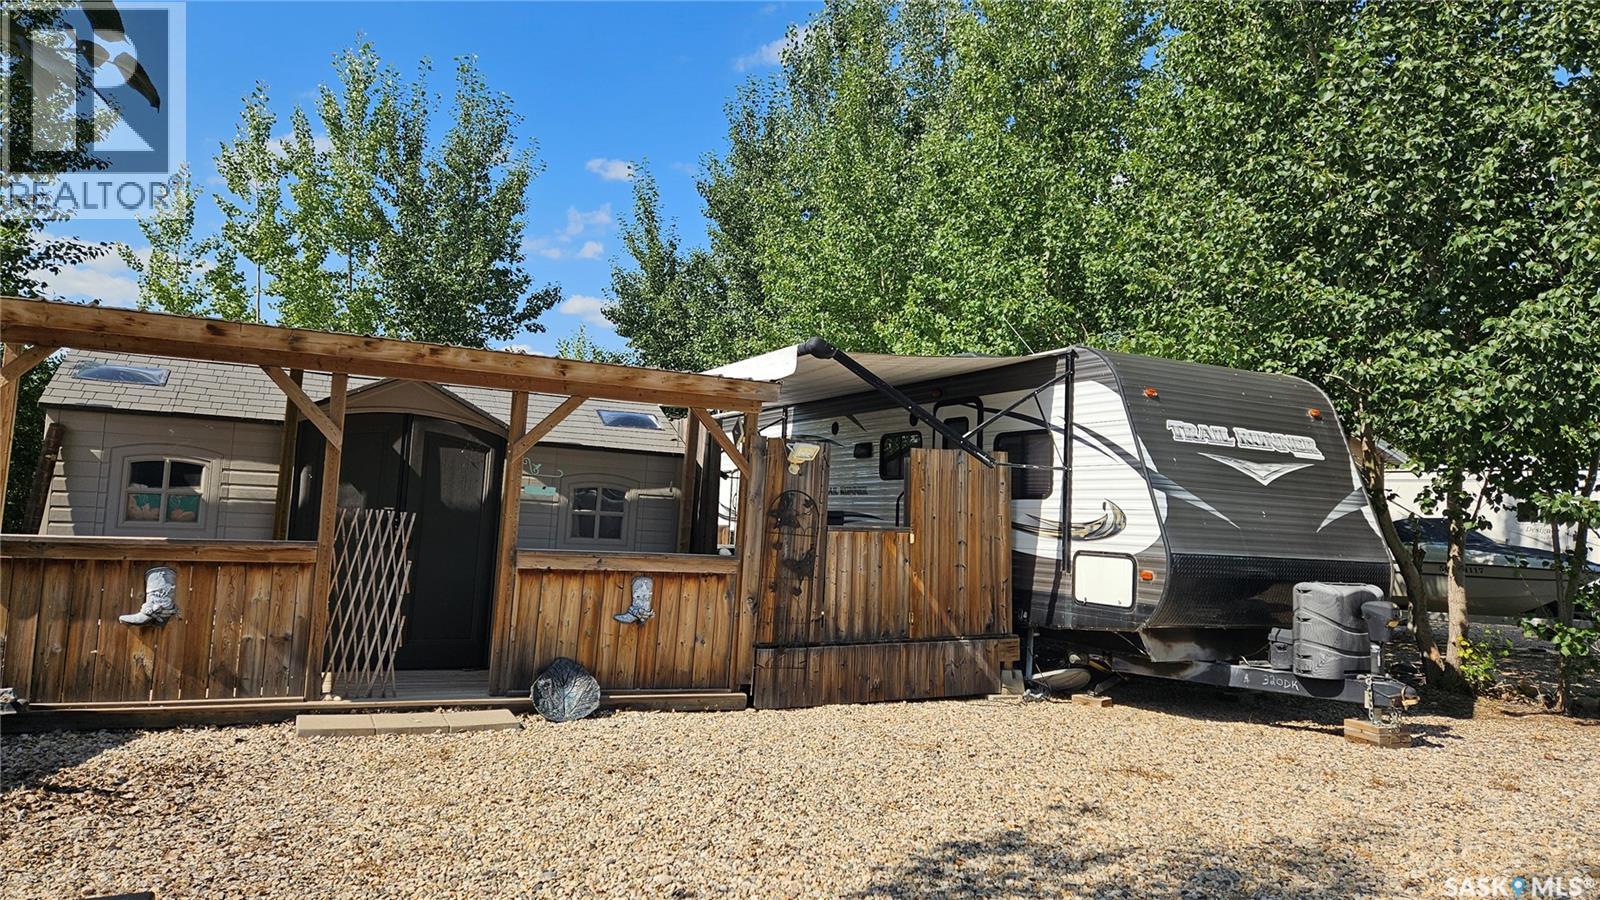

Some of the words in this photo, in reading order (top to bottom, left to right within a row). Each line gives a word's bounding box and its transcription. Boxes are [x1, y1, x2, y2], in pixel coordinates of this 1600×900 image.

[1166, 419, 1236, 447] TRAIL
[1232, 427, 1326, 461] RUNNER
[1262, 674, 1300, 692] 320DK
